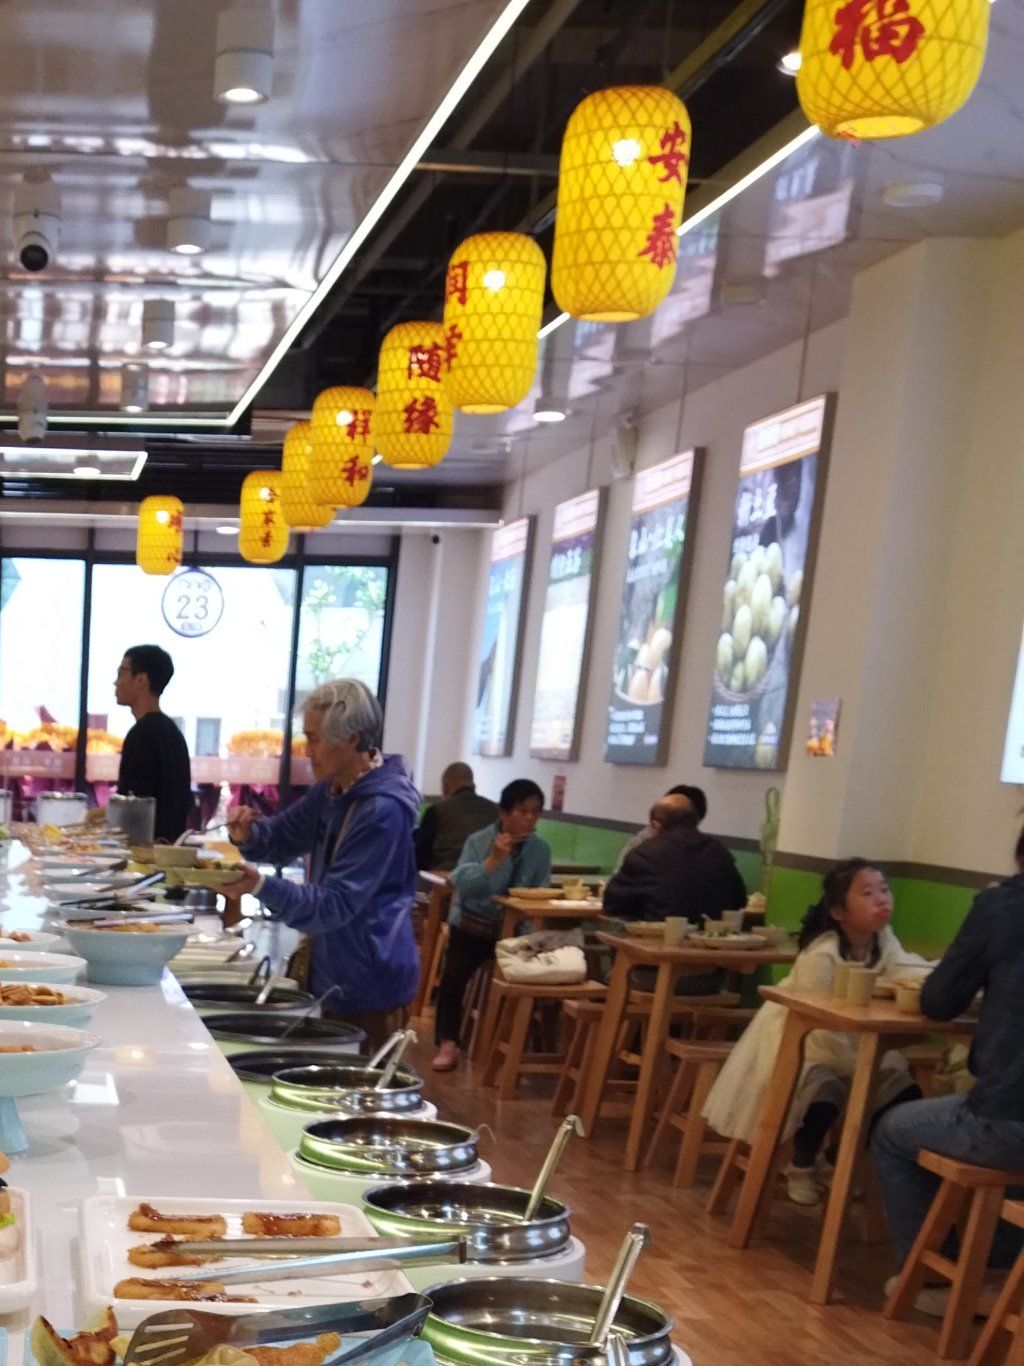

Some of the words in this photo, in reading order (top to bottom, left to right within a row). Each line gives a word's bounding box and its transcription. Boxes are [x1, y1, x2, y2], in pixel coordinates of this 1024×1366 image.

[638, 120, 687, 270] 安泰
[341, 408, 373, 490] 祥和
[176, 594, 209, 620] 23
